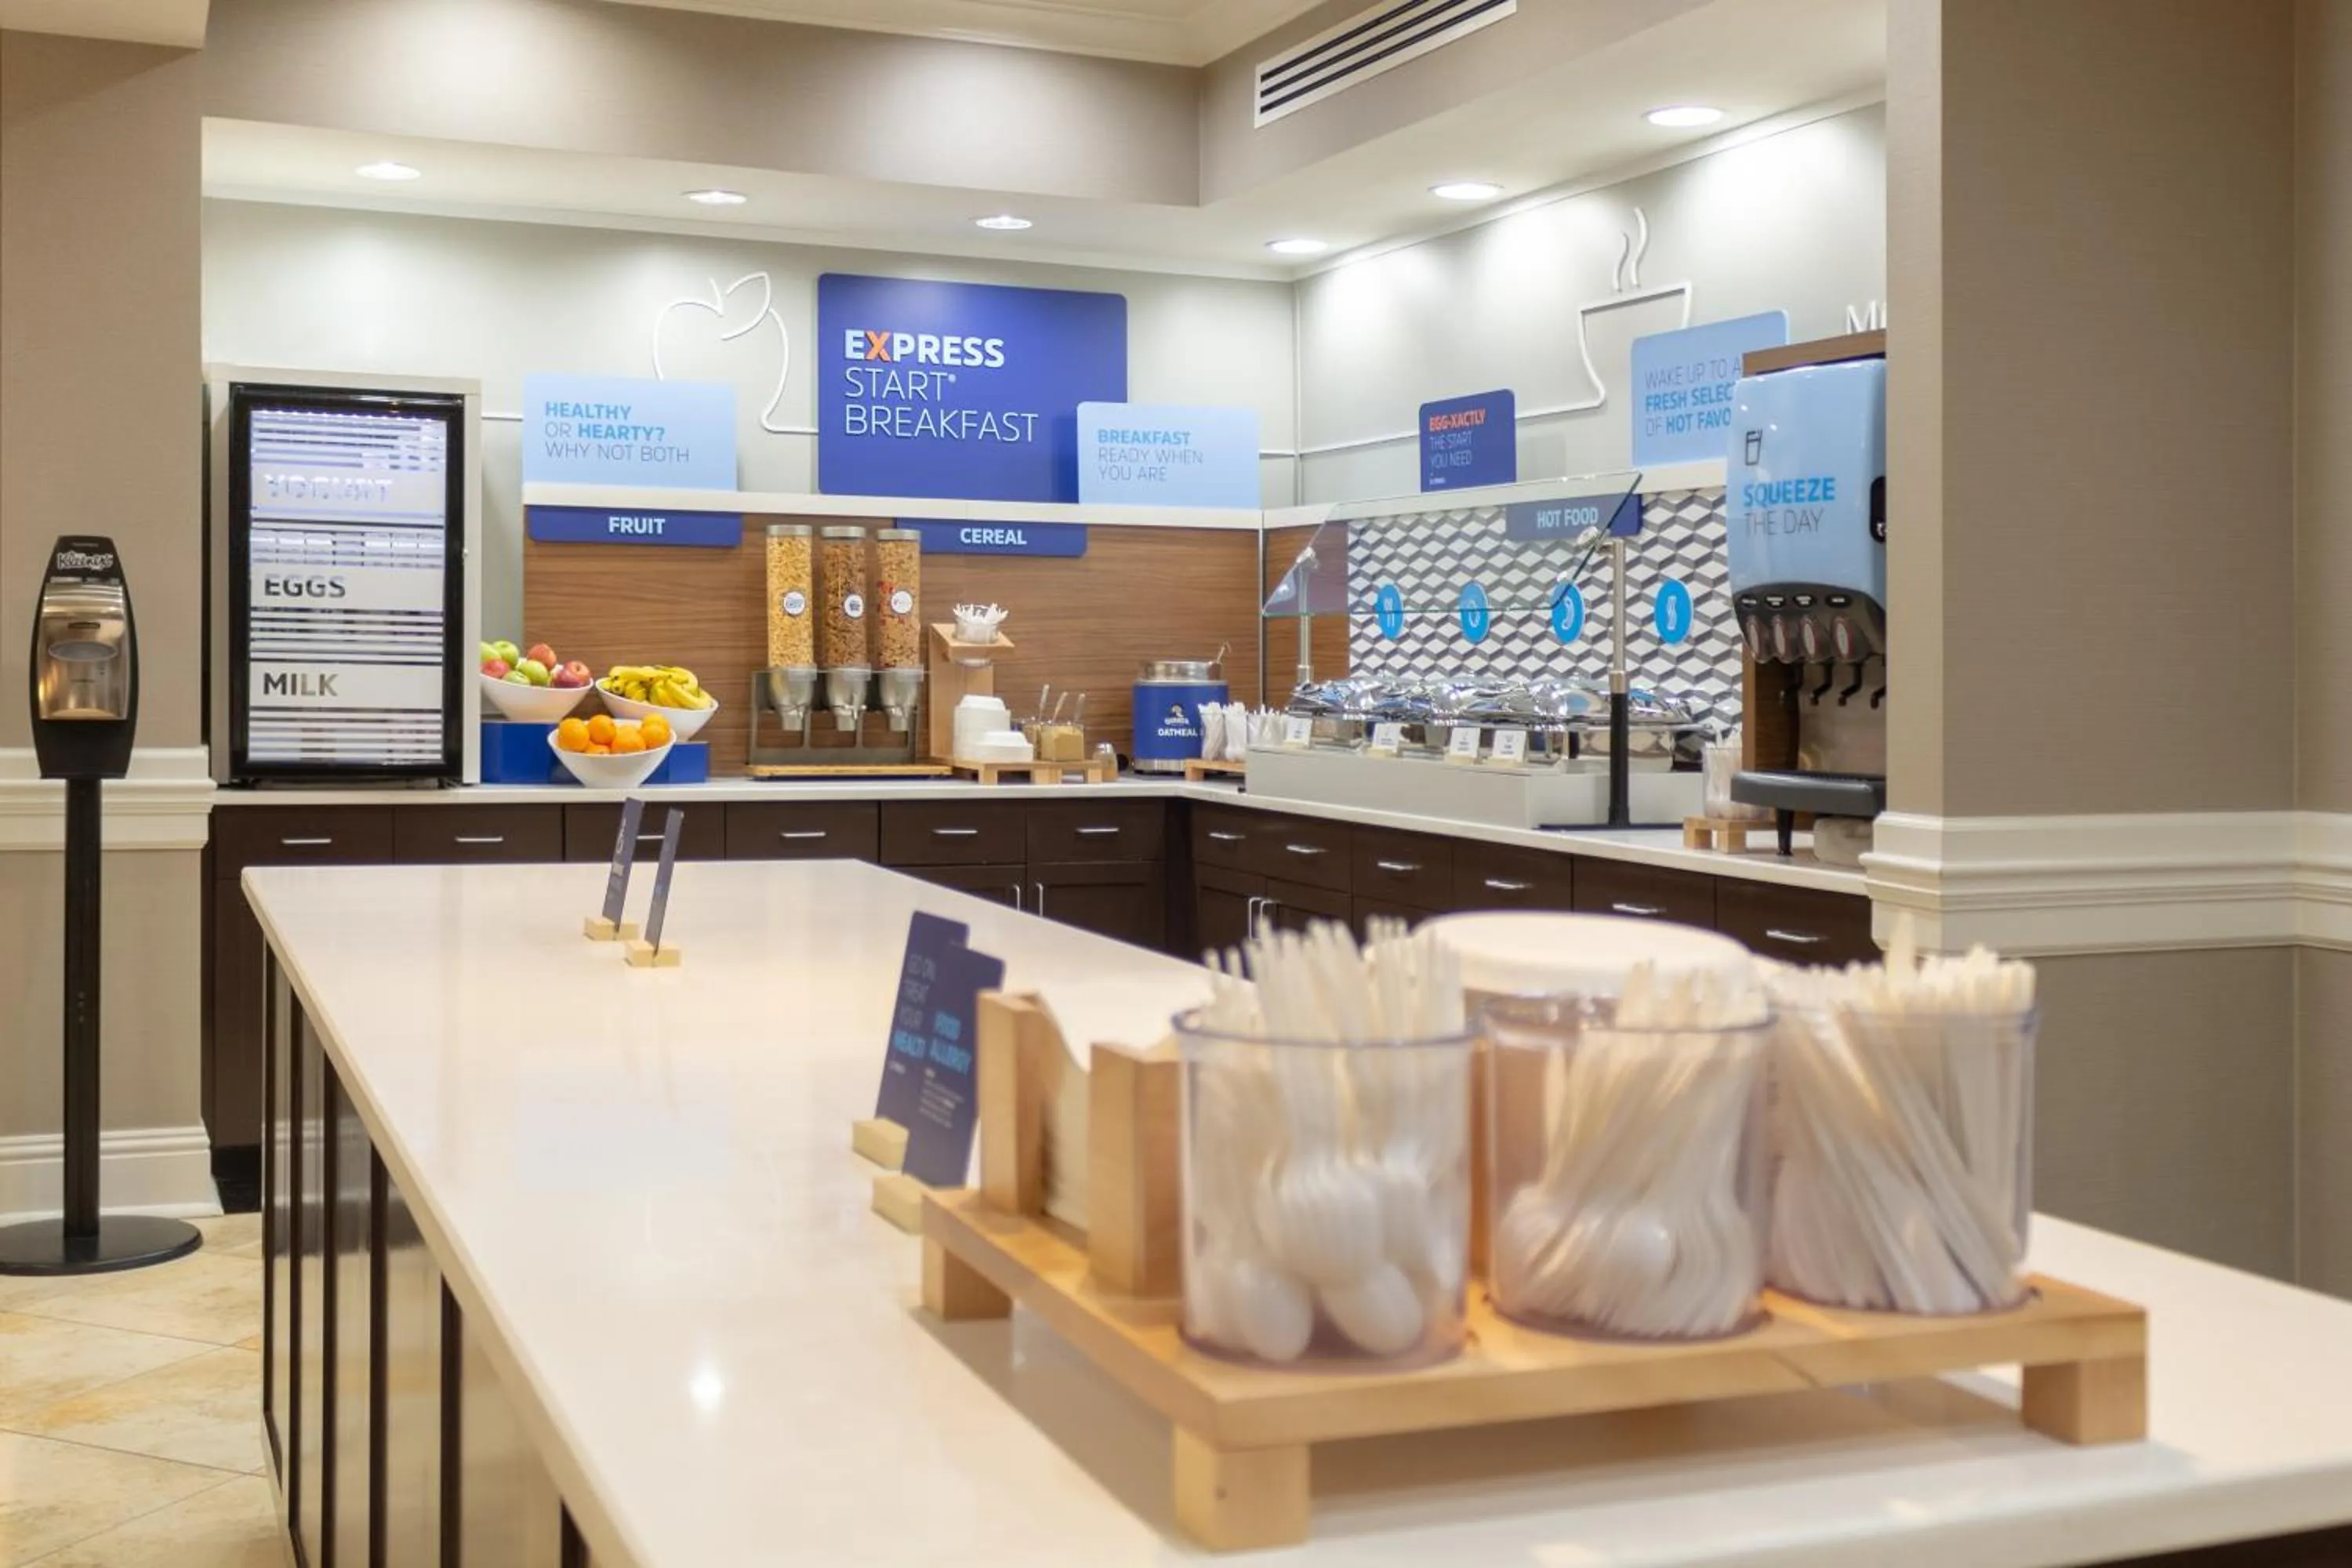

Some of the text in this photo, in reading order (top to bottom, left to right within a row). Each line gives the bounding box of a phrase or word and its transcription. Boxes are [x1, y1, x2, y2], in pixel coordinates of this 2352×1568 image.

[844, 328, 1004, 368] EXPRESS
[1645, 366, 1683, 390] WAKE
[1687, 362, 1704, 384] UP
[1710, 358, 1727, 379] TO
[1646, 380, 1736, 412] FRESH SELEC
[545, 401, 632, 420] HEALTHY
[1429, 408, 1486, 432] EGG-XACTLY
[545, 421, 665, 441] OR HEARTY?
[846, 404, 1039, 442] BREAKFAST
[1646, 416, 1663, 437] OF
[1666, 413, 1694, 434] HOT
[1098, 429, 1191, 445] BREAKFAST
[1429, 429, 1472, 450] THE START
[545, 441, 690, 463] WHY NOT BOTH
[1098, 447, 1204, 465] READY WHEN
[1430, 449, 1472, 469] YOU NEED
[1098, 465, 1167, 481] YOU ARE
[1744, 477, 1836, 510] SQUEEZE
[608, 516, 666, 534] FRUIT
[1537, 507, 1599, 529] HOT FOOD
[1744, 508, 1825, 538] THE DAY
[960, 528, 1028, 545] CEREAL
[263, 573, 346, 598] EGGS
[263, 673, 339, 696] MILK
[1157, 728, 1199, 737] OATMEAL
